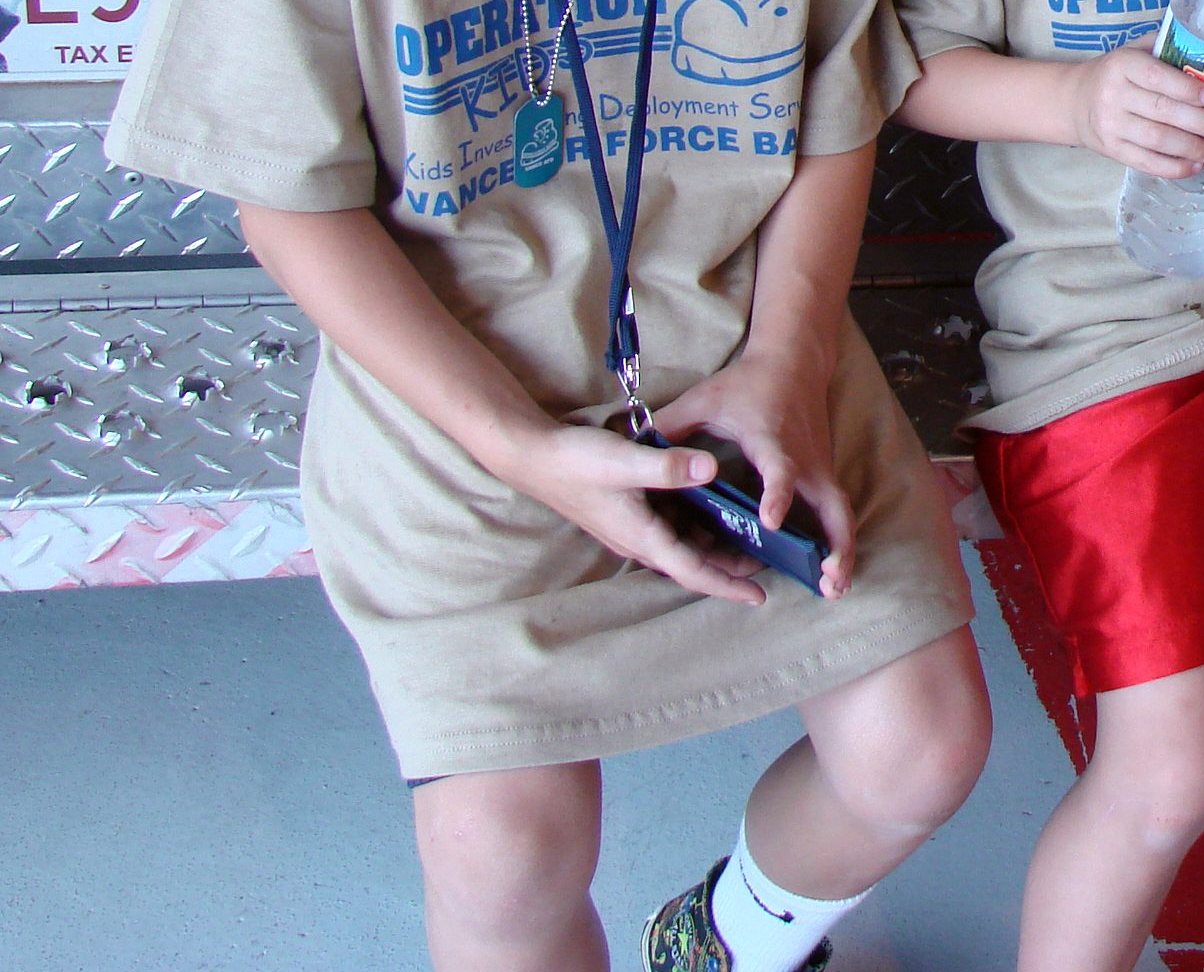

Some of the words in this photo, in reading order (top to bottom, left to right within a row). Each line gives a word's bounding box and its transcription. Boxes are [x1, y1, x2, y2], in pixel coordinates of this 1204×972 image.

[54, 45, 109, 64] TAX
[405, 152, 454, 181] Kids
[406, 158, 515, 217] VANCE
